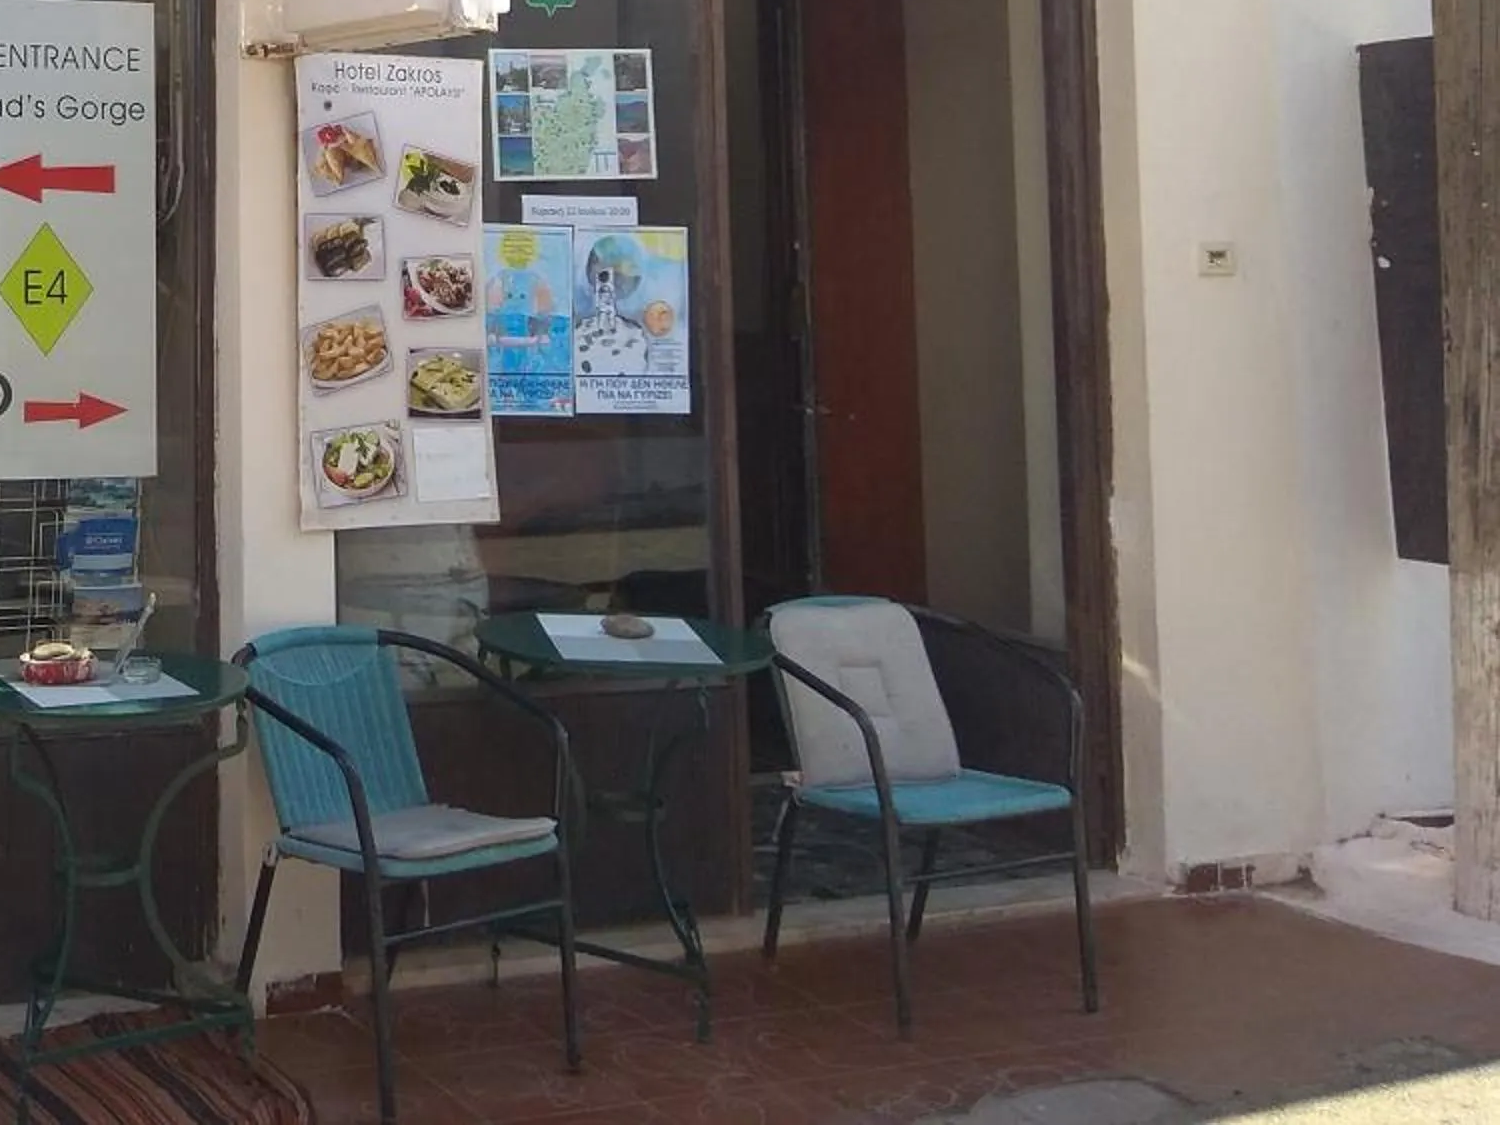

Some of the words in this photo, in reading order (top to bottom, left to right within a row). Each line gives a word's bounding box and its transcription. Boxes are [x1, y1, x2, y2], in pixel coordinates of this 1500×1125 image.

[334, 60, 381, 81] Hotel
[387, 63, 442, 83] Zakros
[57, 95, 146, 127] Gorge
[23, 269, 68, 305] E4
